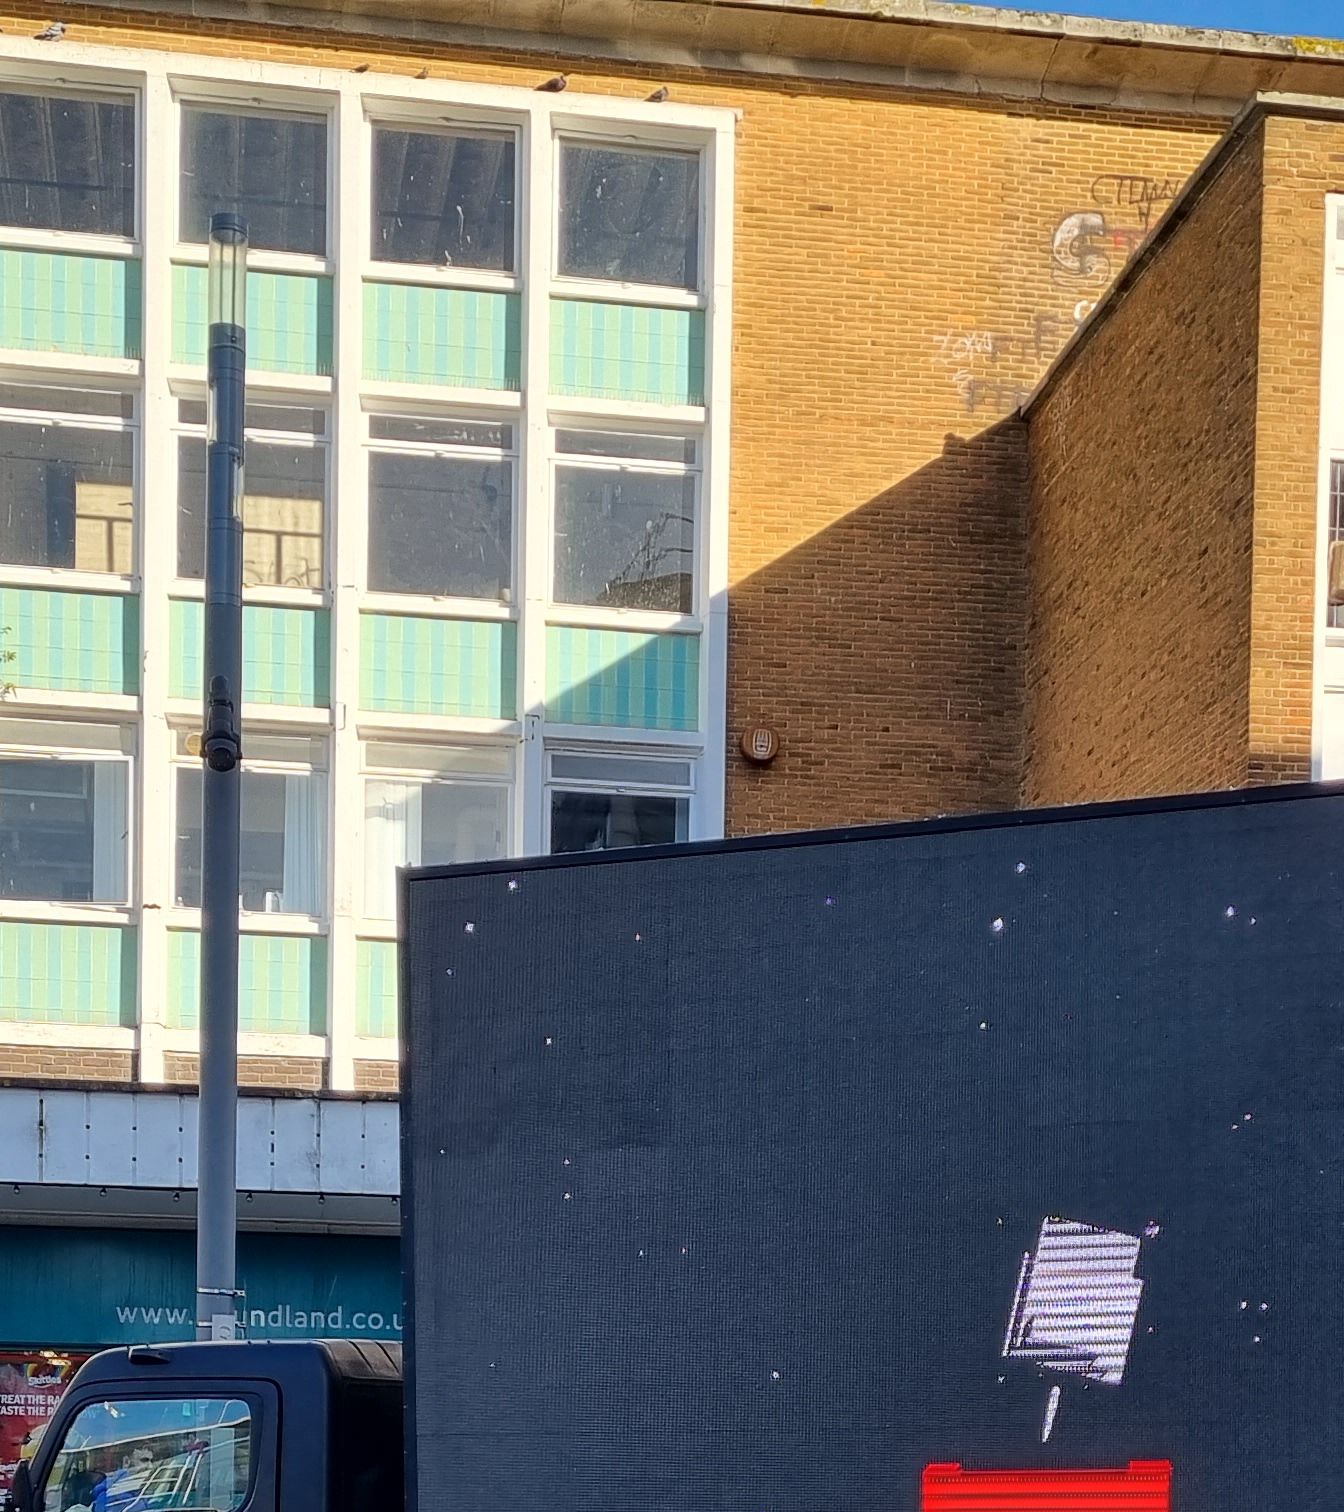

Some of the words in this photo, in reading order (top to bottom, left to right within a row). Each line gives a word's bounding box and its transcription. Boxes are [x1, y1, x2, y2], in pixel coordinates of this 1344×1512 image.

[115, 1304, 404, 1331] www.undland.co.u
[27, 1394, 47, 1405] THE
[47, 1395, 62, 1405] RA
[27, 1406, 47, 1416] THE
